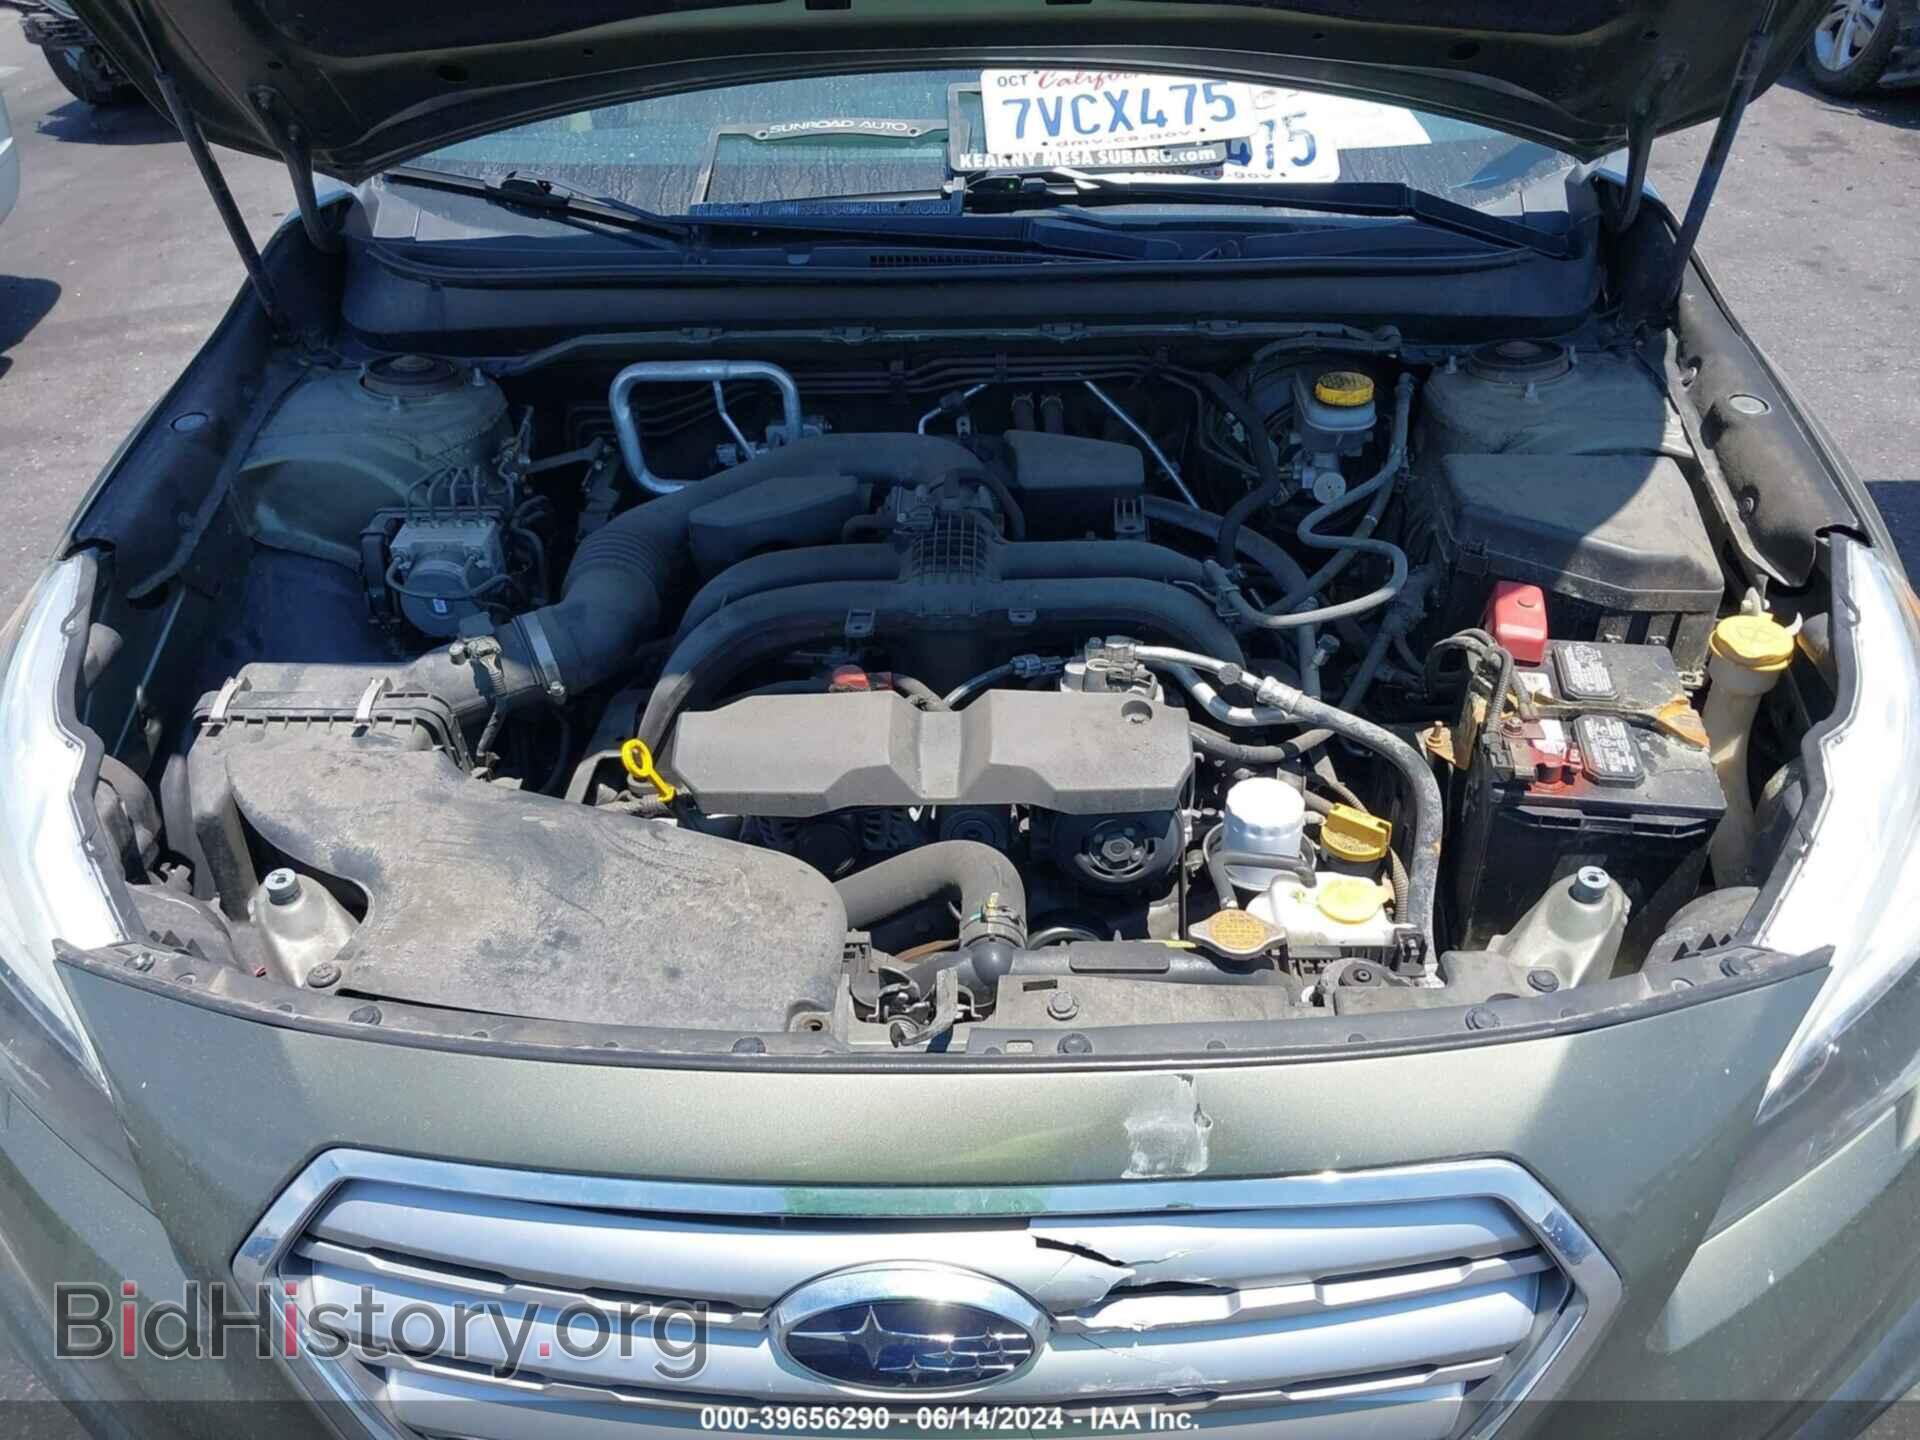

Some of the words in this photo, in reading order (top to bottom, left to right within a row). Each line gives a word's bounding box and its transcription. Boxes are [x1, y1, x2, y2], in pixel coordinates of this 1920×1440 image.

[997, 75, 1028, 88] OCT
[1002, 80, 1236, 139] 7VCX475
[769, 119, 854, 133] SUNROAD
[859, 120, 908, 131] AUTO
[1055, 129, 1193, 147] dmv.ca.gov
[960, 152, 1039, 168] KEARNY
[1042, 149, 1095, 167] MESA
